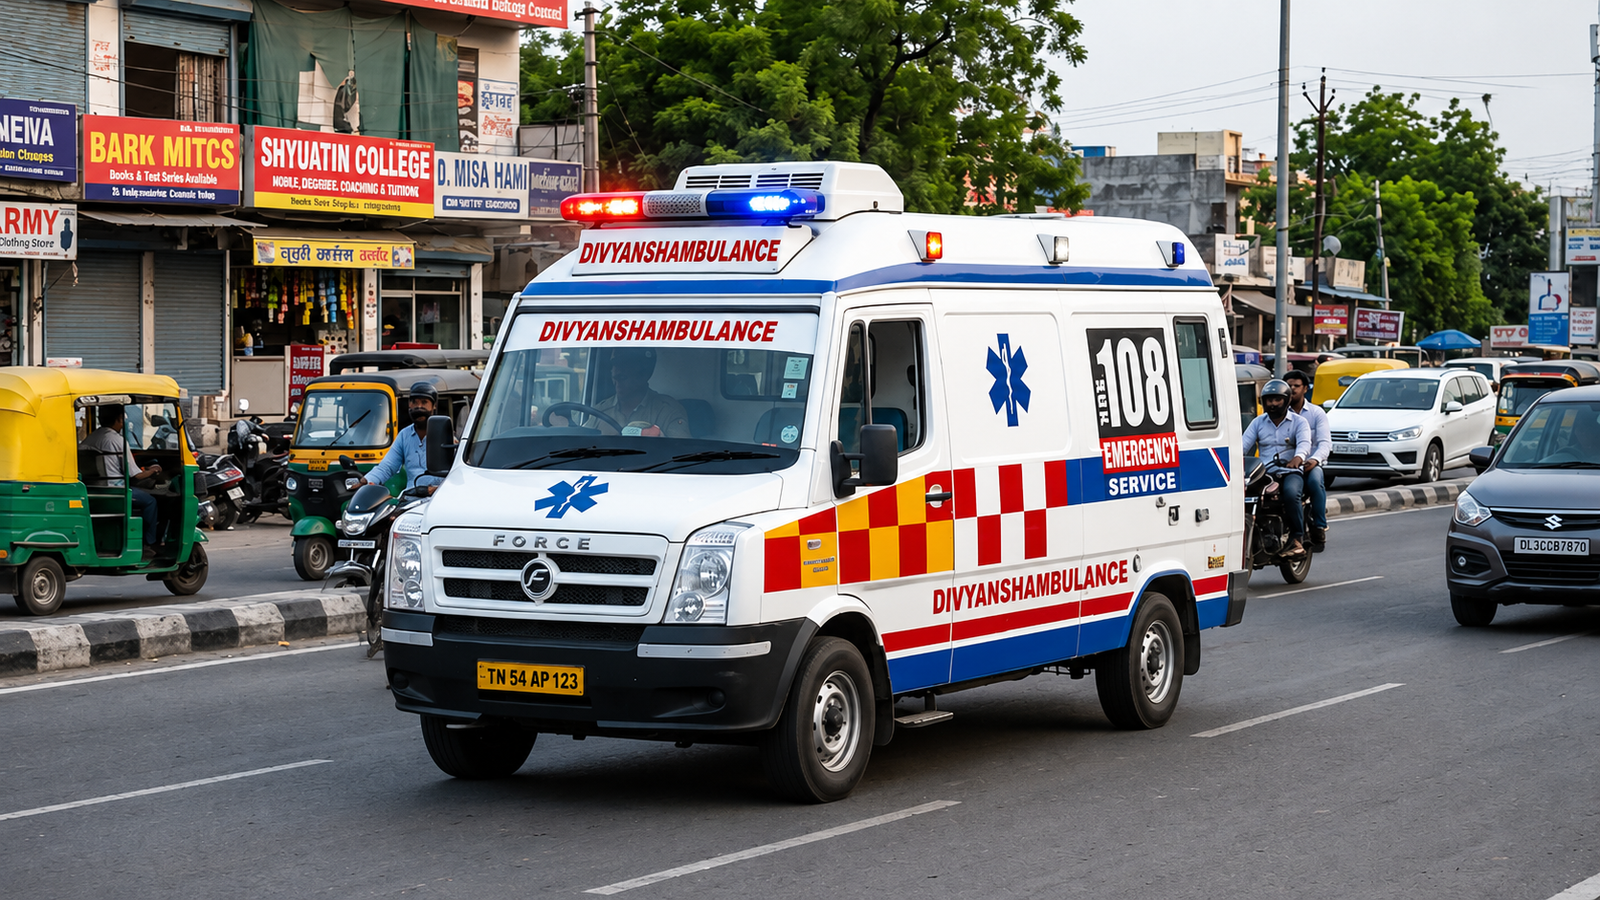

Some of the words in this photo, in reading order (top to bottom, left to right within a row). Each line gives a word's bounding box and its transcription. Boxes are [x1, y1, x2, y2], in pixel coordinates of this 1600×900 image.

[90, 131, 156, 166] BARK
[163, 135, 235, 169] MITCS
[261, 136, 350, 173] SHYUATIN
[355, 144, 431, 180] COLLEGE
[109, 169, 134, 181] Books
[136, 170, 142, 181] &
[144, 171, 161, 182] Test
[437, 158, 450, 187] D.
[454, 159, 489, 189] MISA
[494, 161, 527, 190] HAMI
[0, 207, 59, 235] RMY
[31, 238, 55, 248] Store
[578, 239, 781, 264] DIVYANSHAMBULANCE
[538, 320, 778, 342] DIVYANSHAMBULANCE
[1095, 336, 1170, 428] 108
[1103, 436, 1177, 470] EMERGENCY
[1108, 471, 1177, 497] SERVICE
[492, 534, 591, 551] FORCE
[1520, 539, 1587, 553] DL3CCB7870
[932, 559, 1129, 615] DIVYANSHAMBULANCE
[487, 668, 506, 685] TN
[509, 669, 527, 687] 54
[530, 670, 550, 688] AP
[552, 671, 578, 690] 123
